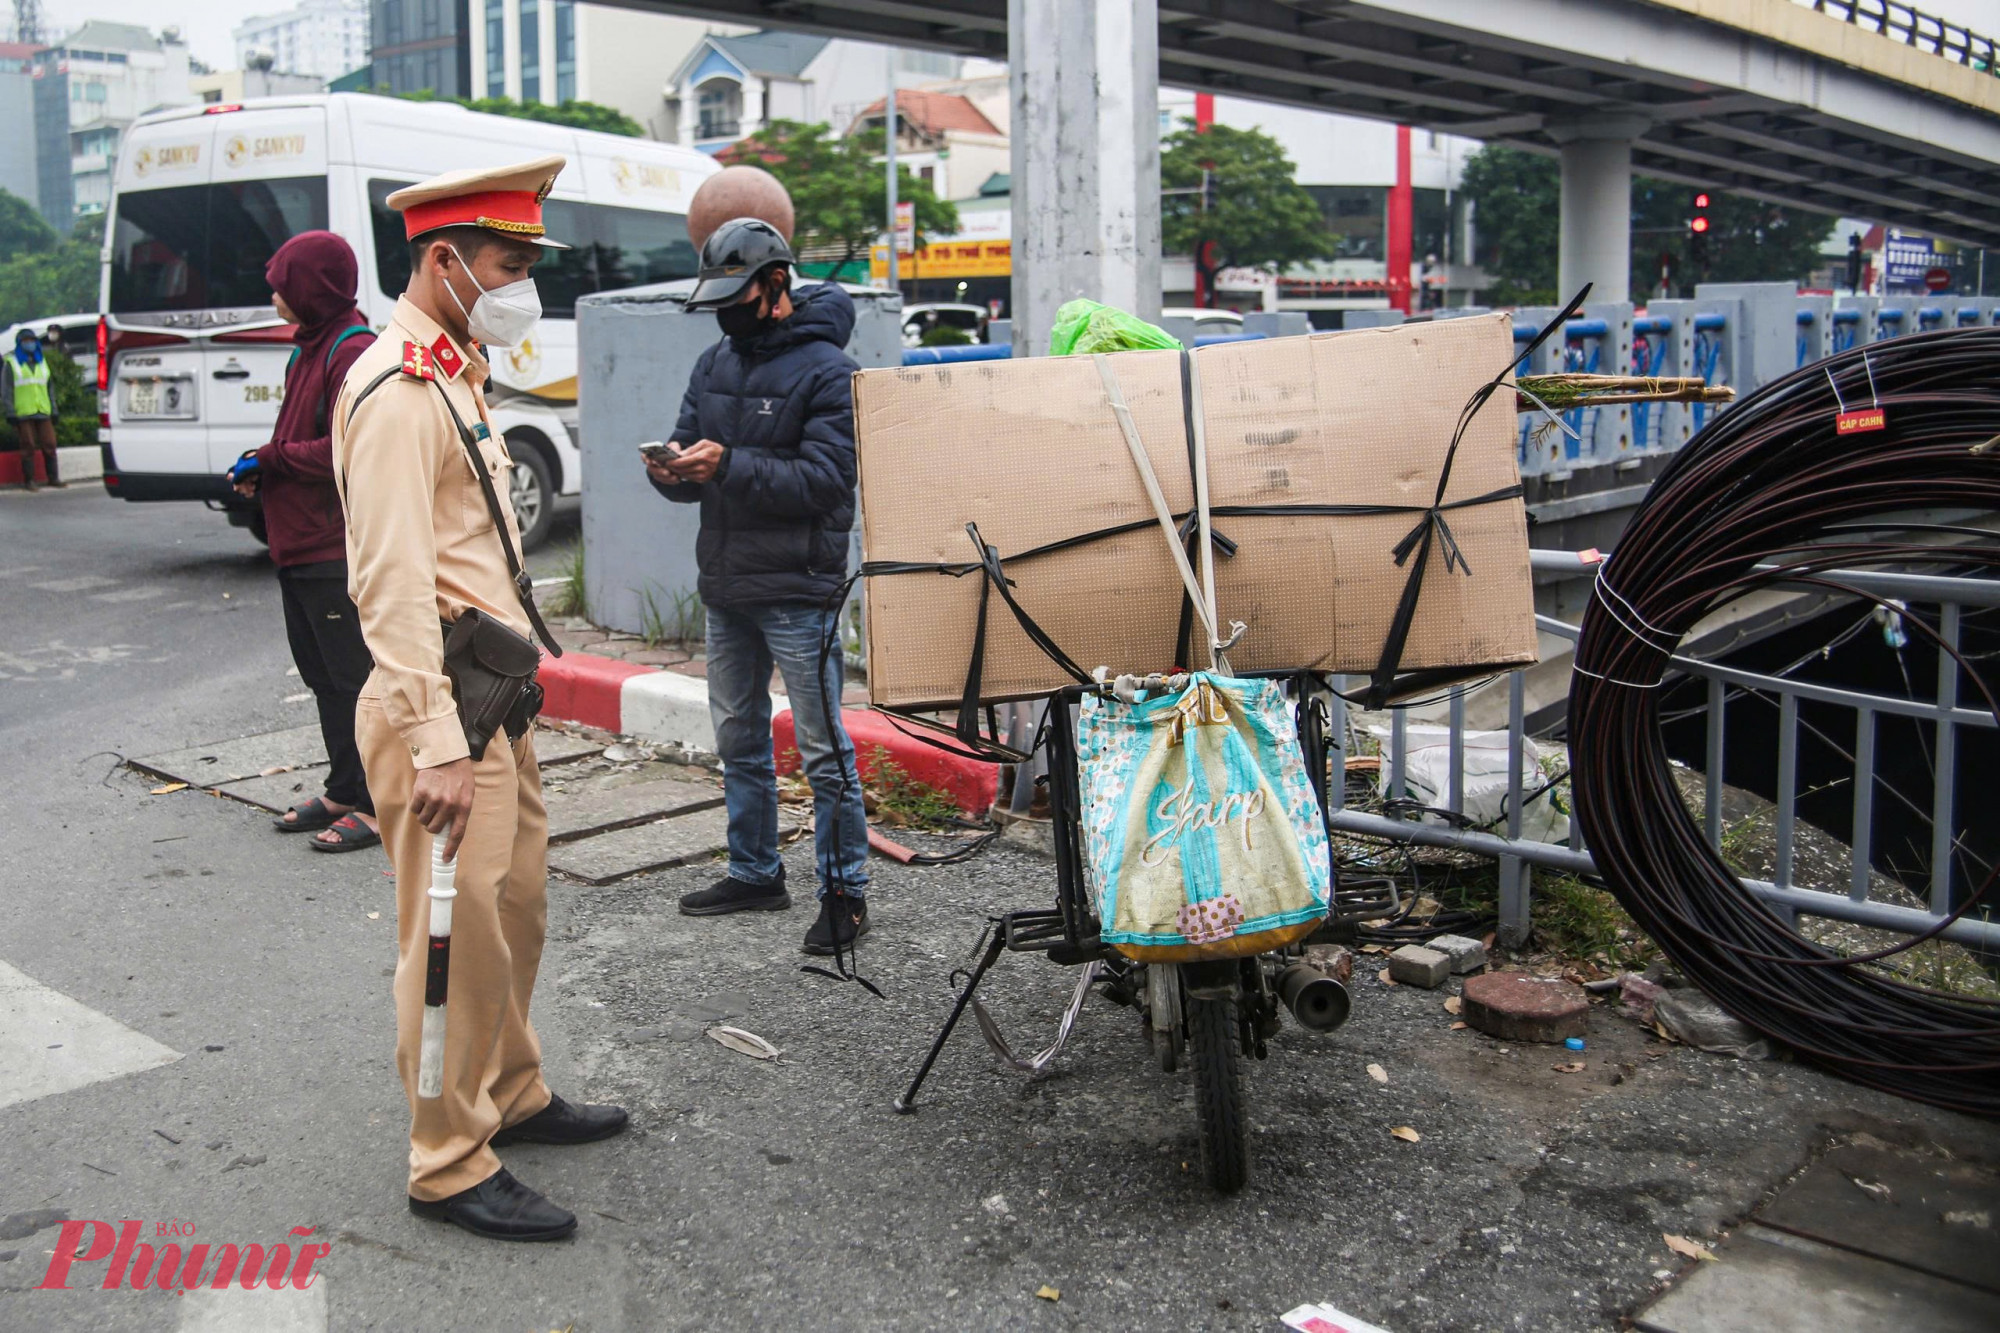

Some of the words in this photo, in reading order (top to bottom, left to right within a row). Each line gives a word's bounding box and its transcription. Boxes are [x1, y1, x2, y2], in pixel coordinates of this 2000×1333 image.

[158, 145, 201, 167] SANKYU
[254, 135, 306, 157] SANKYU
[244, 385, 285, 403] 29B-4
[1839, 417, 1858, 431] CÁP
